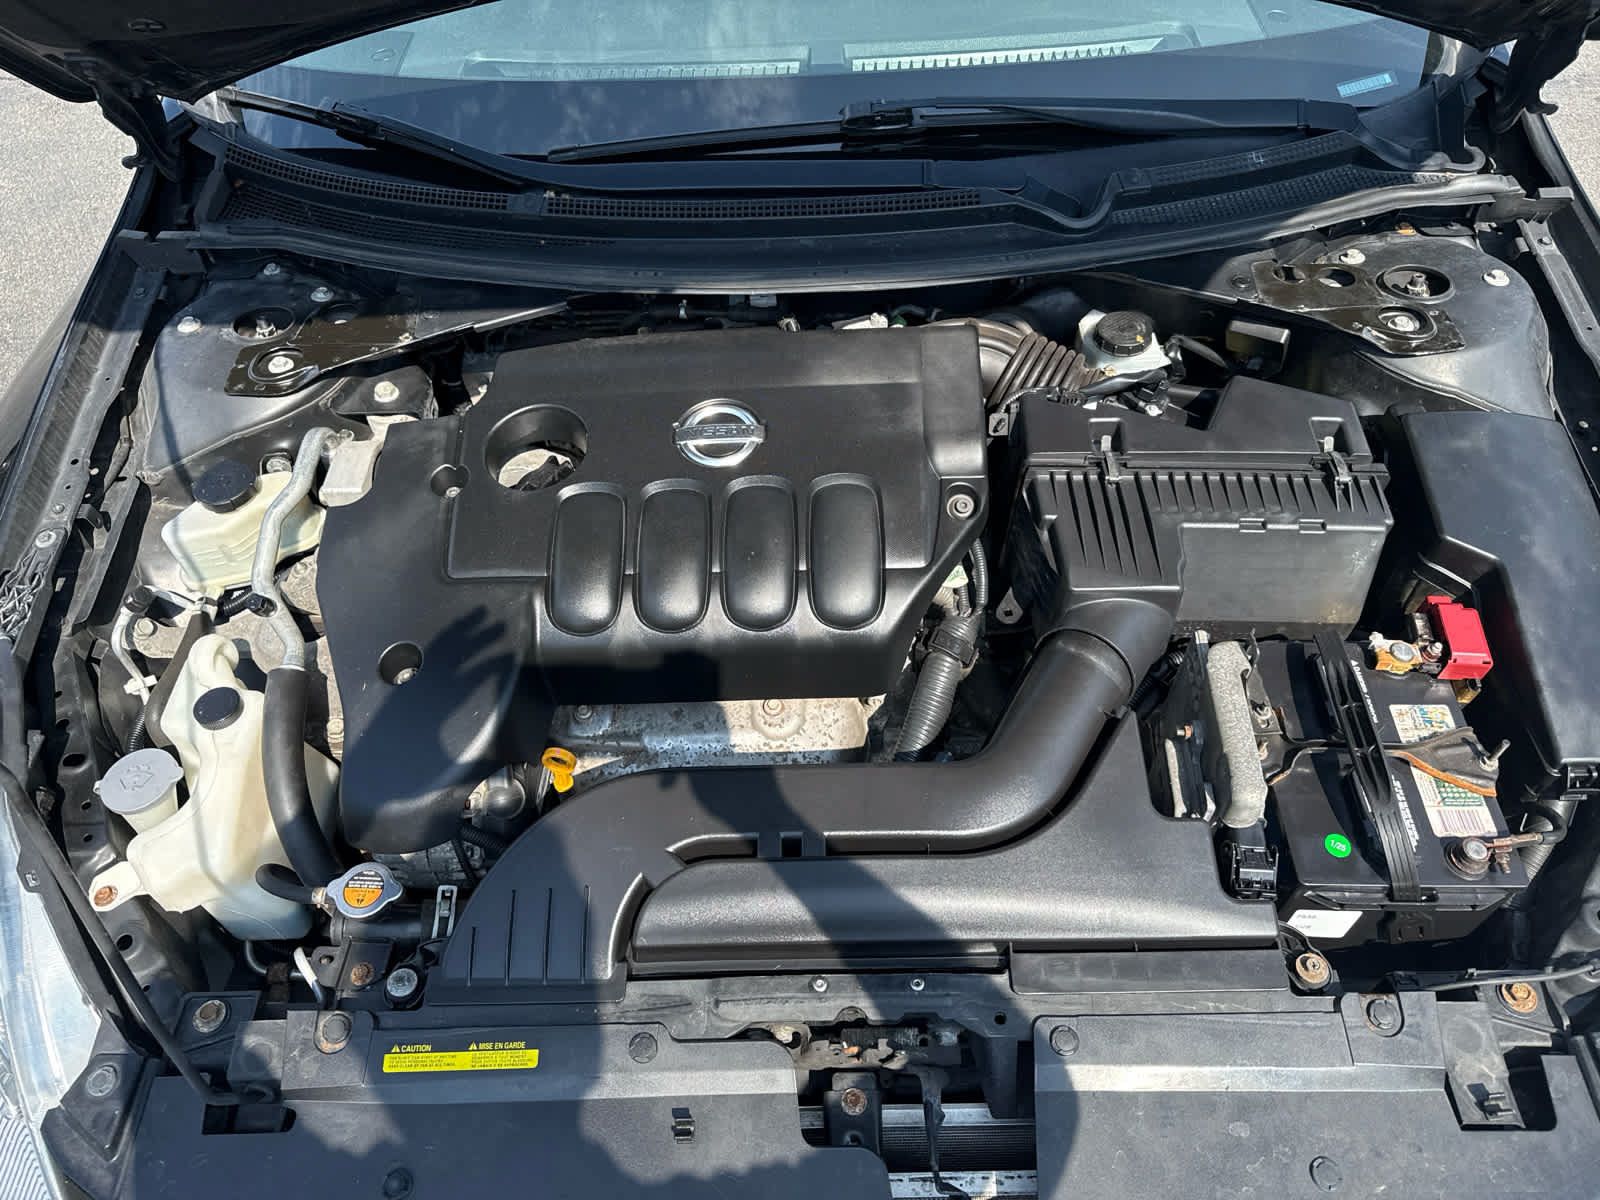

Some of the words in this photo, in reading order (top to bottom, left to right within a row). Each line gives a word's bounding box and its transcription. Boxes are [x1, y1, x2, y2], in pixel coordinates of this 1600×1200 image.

[686, 425, 756, 438] NISSAN
[1330, 839, 1346, 852] 1/25
[401, 1043, 432, 1053] CAUTION
[478, 1042, 494, 1050] MISE
[494, 1042, 504, 1050] EN
[504, 1041, 526, 1049] GARDE
